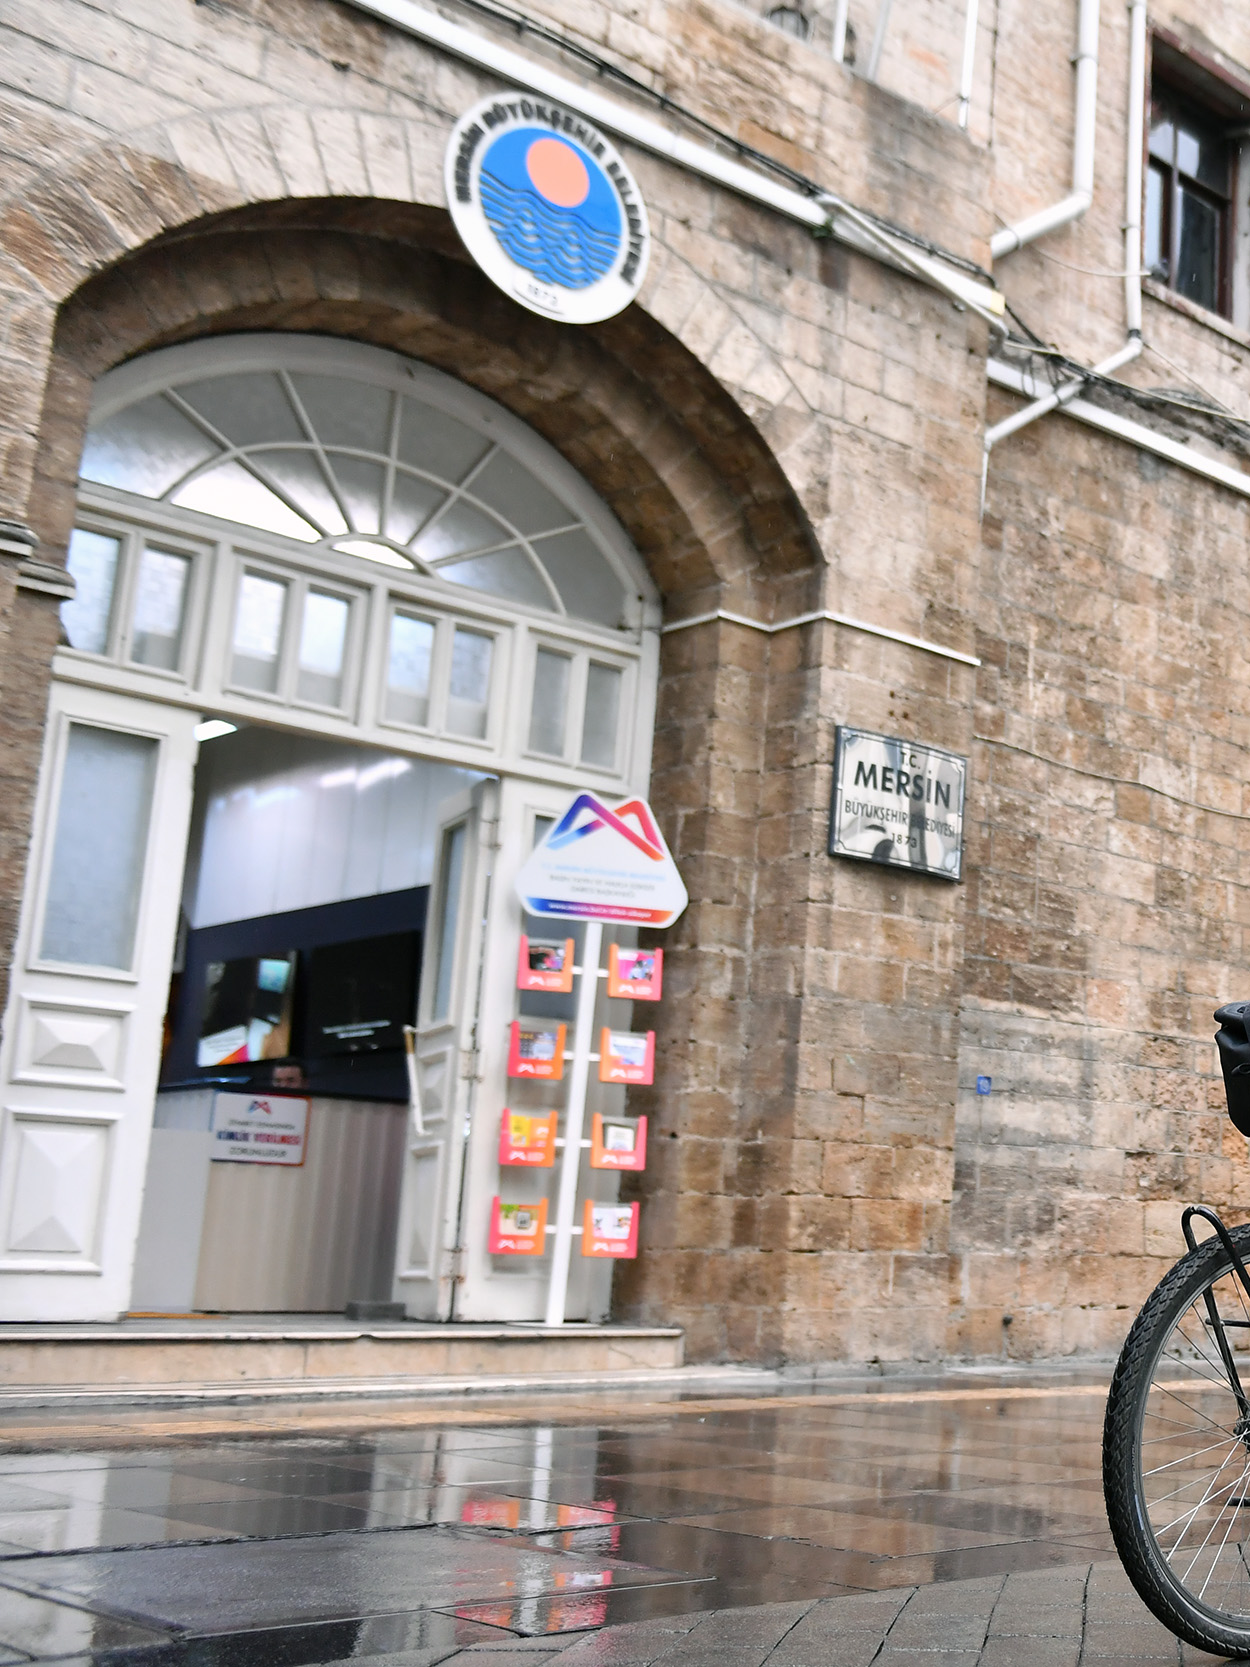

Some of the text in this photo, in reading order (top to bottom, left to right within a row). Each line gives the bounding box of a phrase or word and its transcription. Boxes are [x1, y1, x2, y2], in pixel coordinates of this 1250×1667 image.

[900, 751, 921, 770] T.C.
[854, 760, 951, 810] MERSİN
[891, 832, 918, 849] 1873
